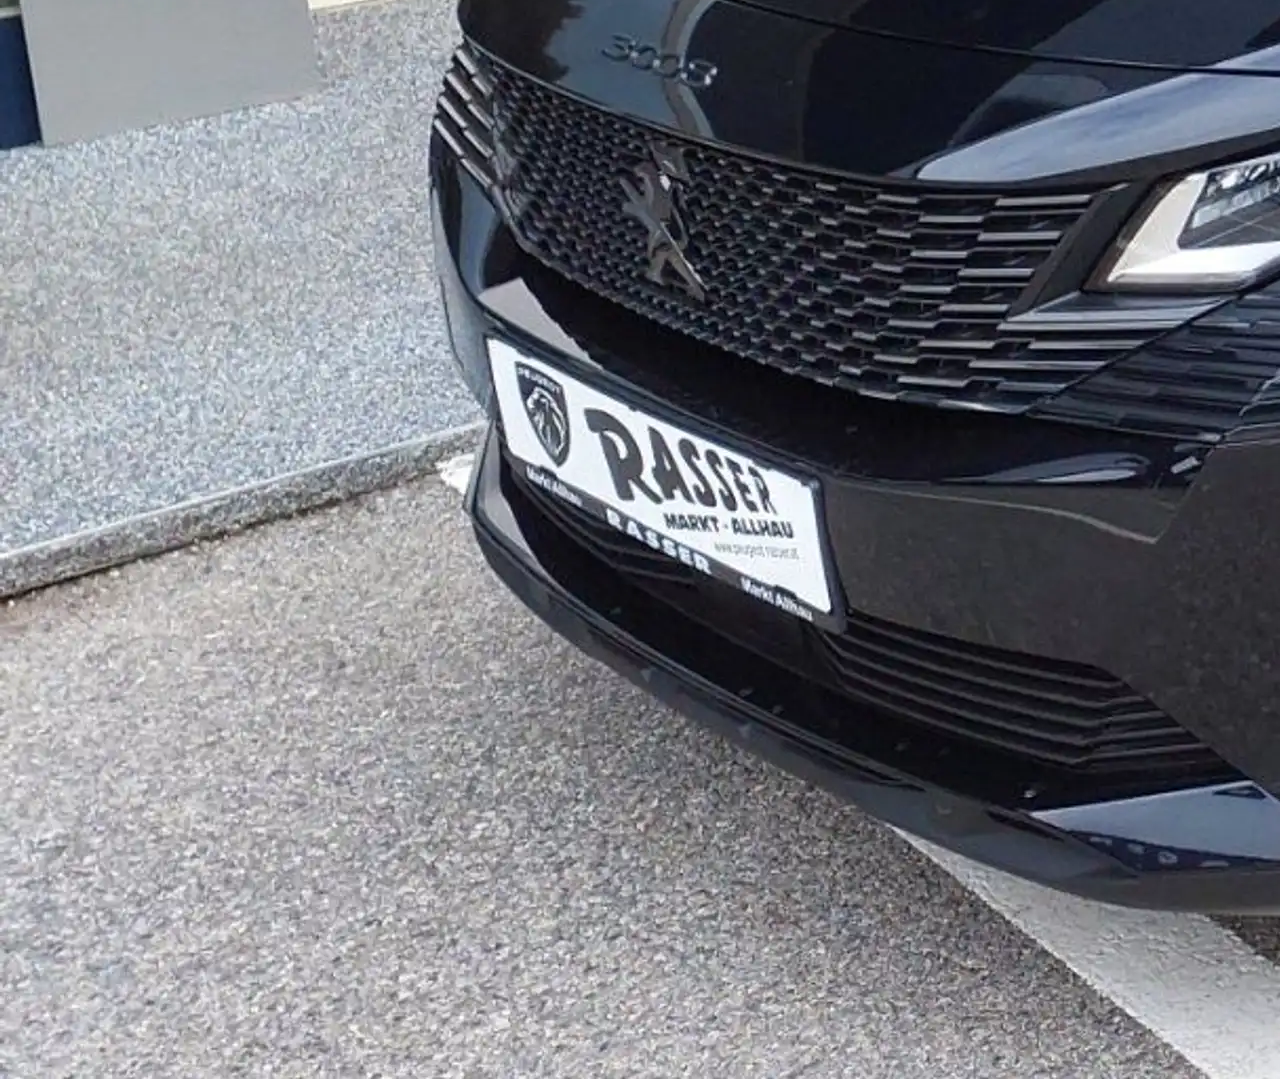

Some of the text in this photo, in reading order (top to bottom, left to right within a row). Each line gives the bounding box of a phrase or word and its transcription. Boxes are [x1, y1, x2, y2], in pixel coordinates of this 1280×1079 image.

[601, 33, 718, 88] 3008
[583, 407, 779, 516] RASSER
[605, 507, 713, 577] RASSER
[663, 512, 720, 533] MARKT
[731, 516, 794, 539] ALLHAU
